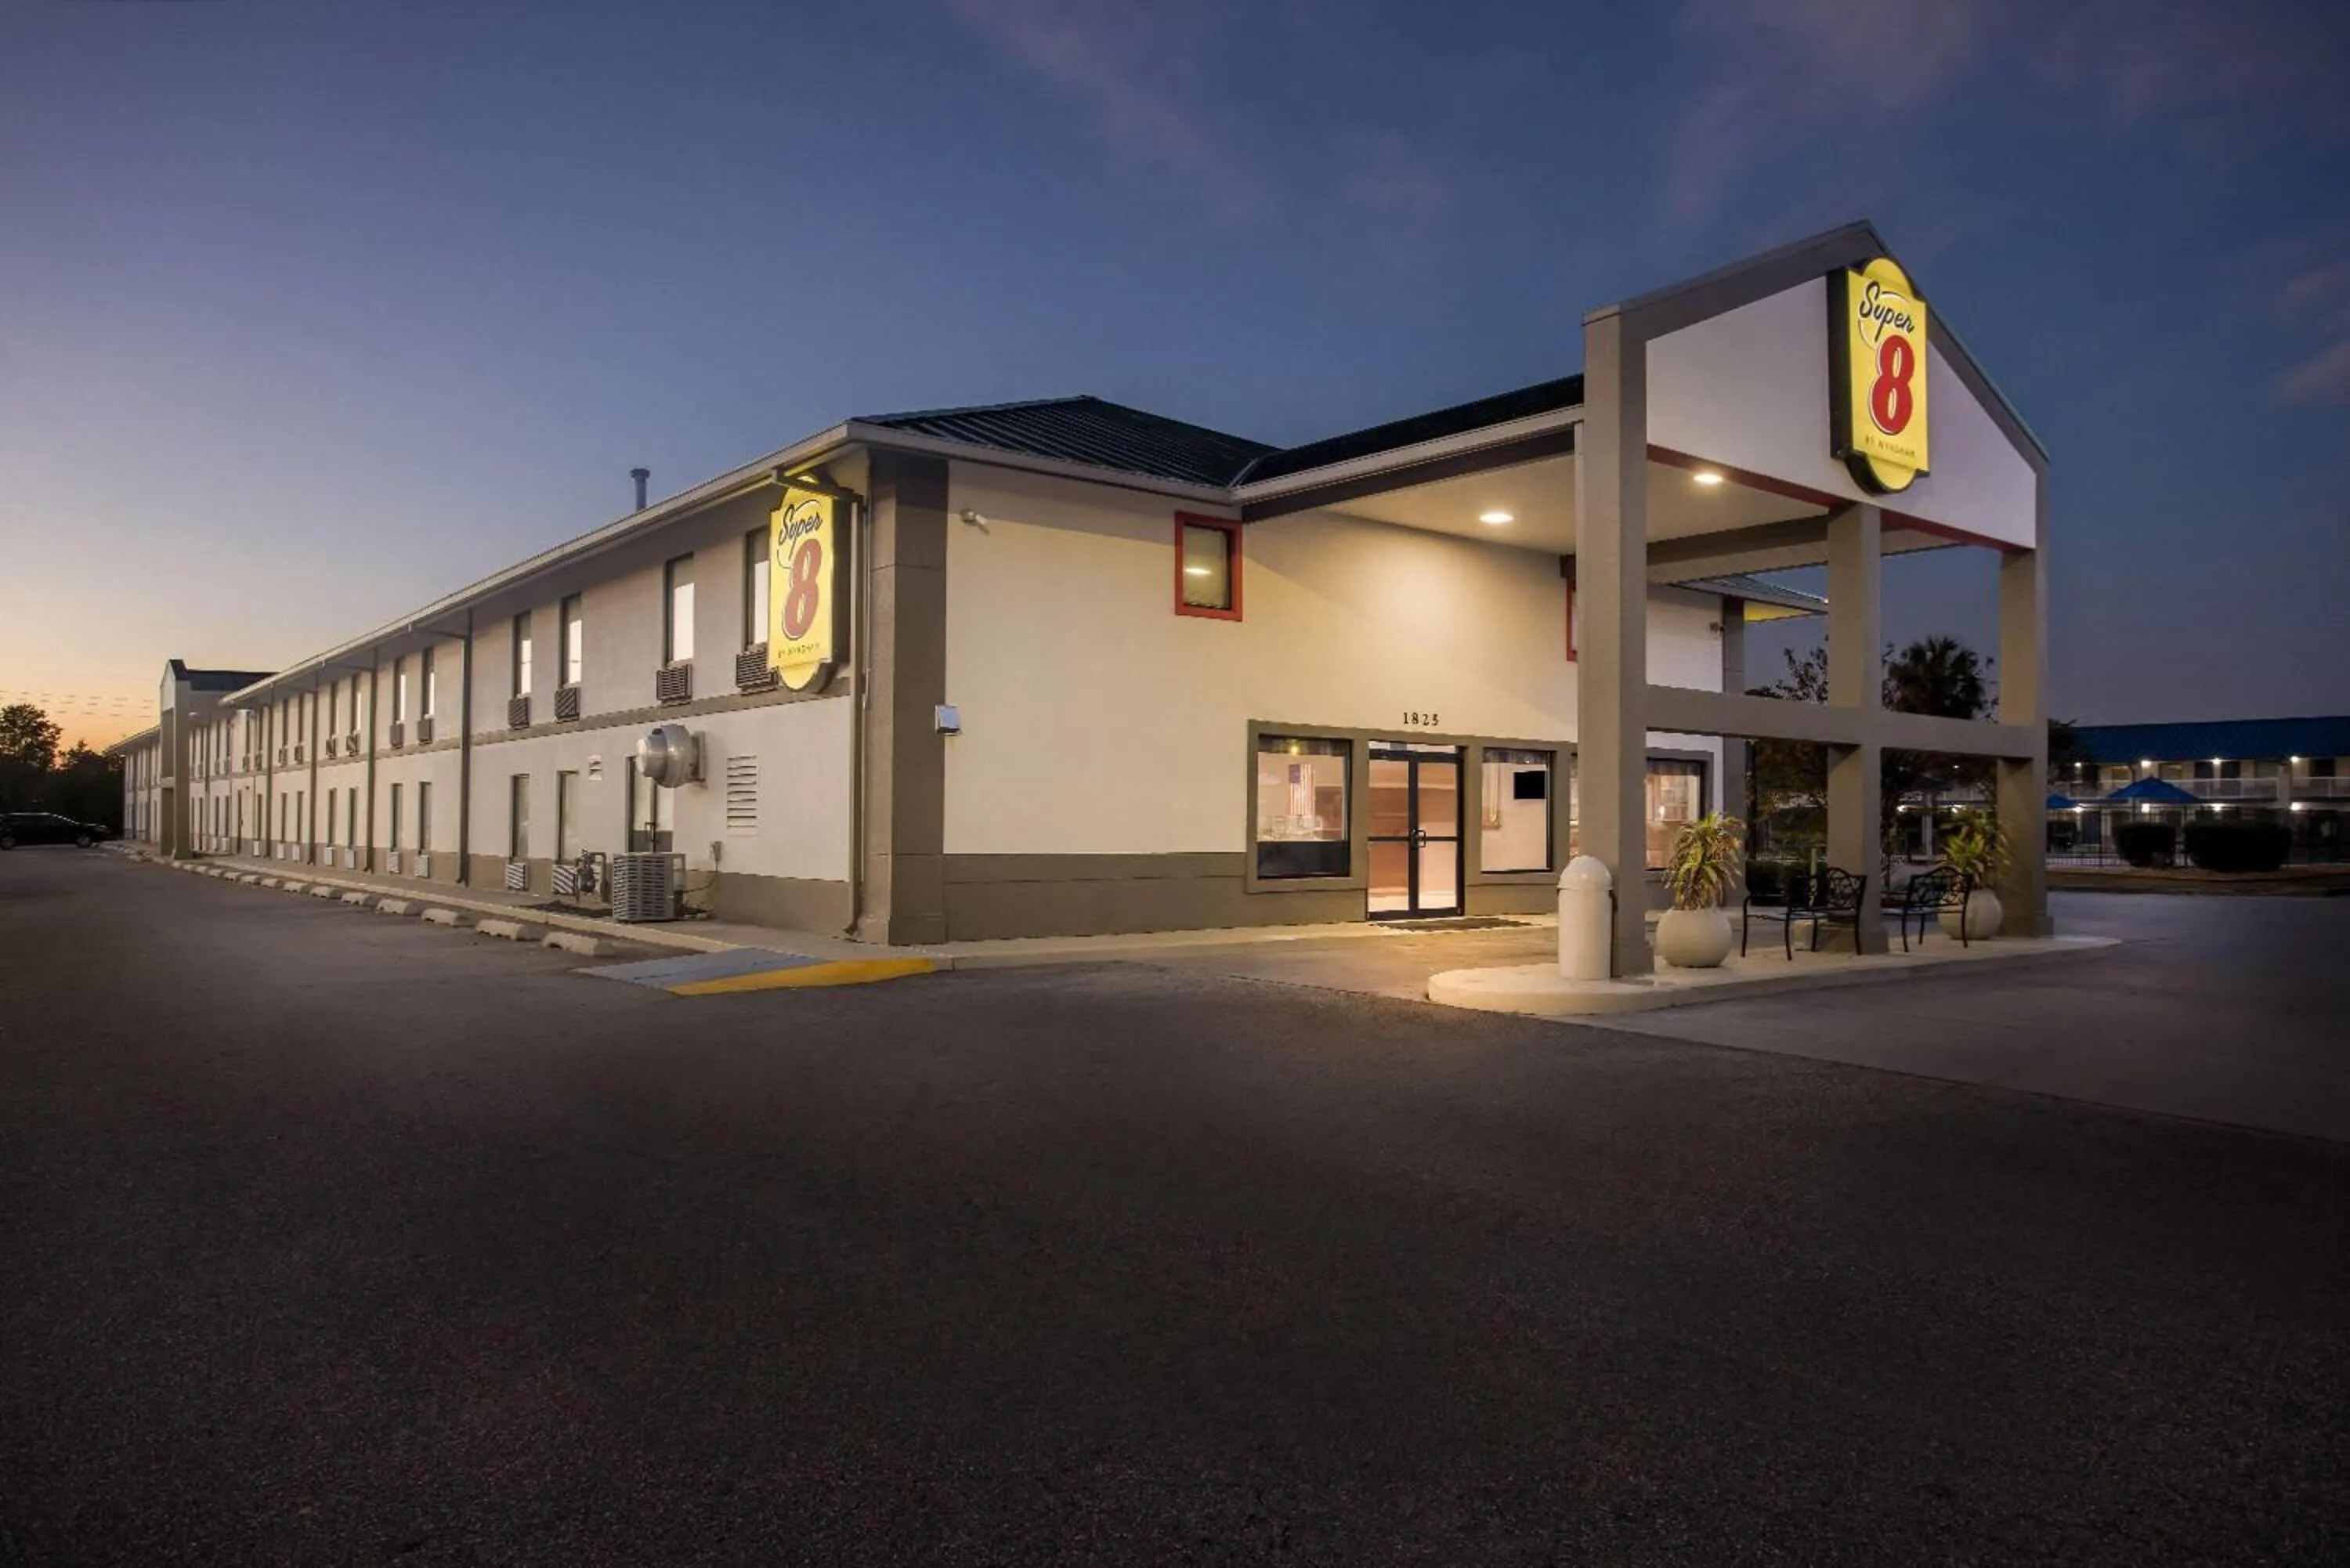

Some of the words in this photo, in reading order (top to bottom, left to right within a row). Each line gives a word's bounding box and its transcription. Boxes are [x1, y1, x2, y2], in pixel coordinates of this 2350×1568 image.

[1859, 280, 1914, 341] Super
[1869, 334, 1915, 435] 8
[778, 504, 822, 561] Super
[782, 538, 822, 641] 8
[1403, 712, 1439, 726] 1825
